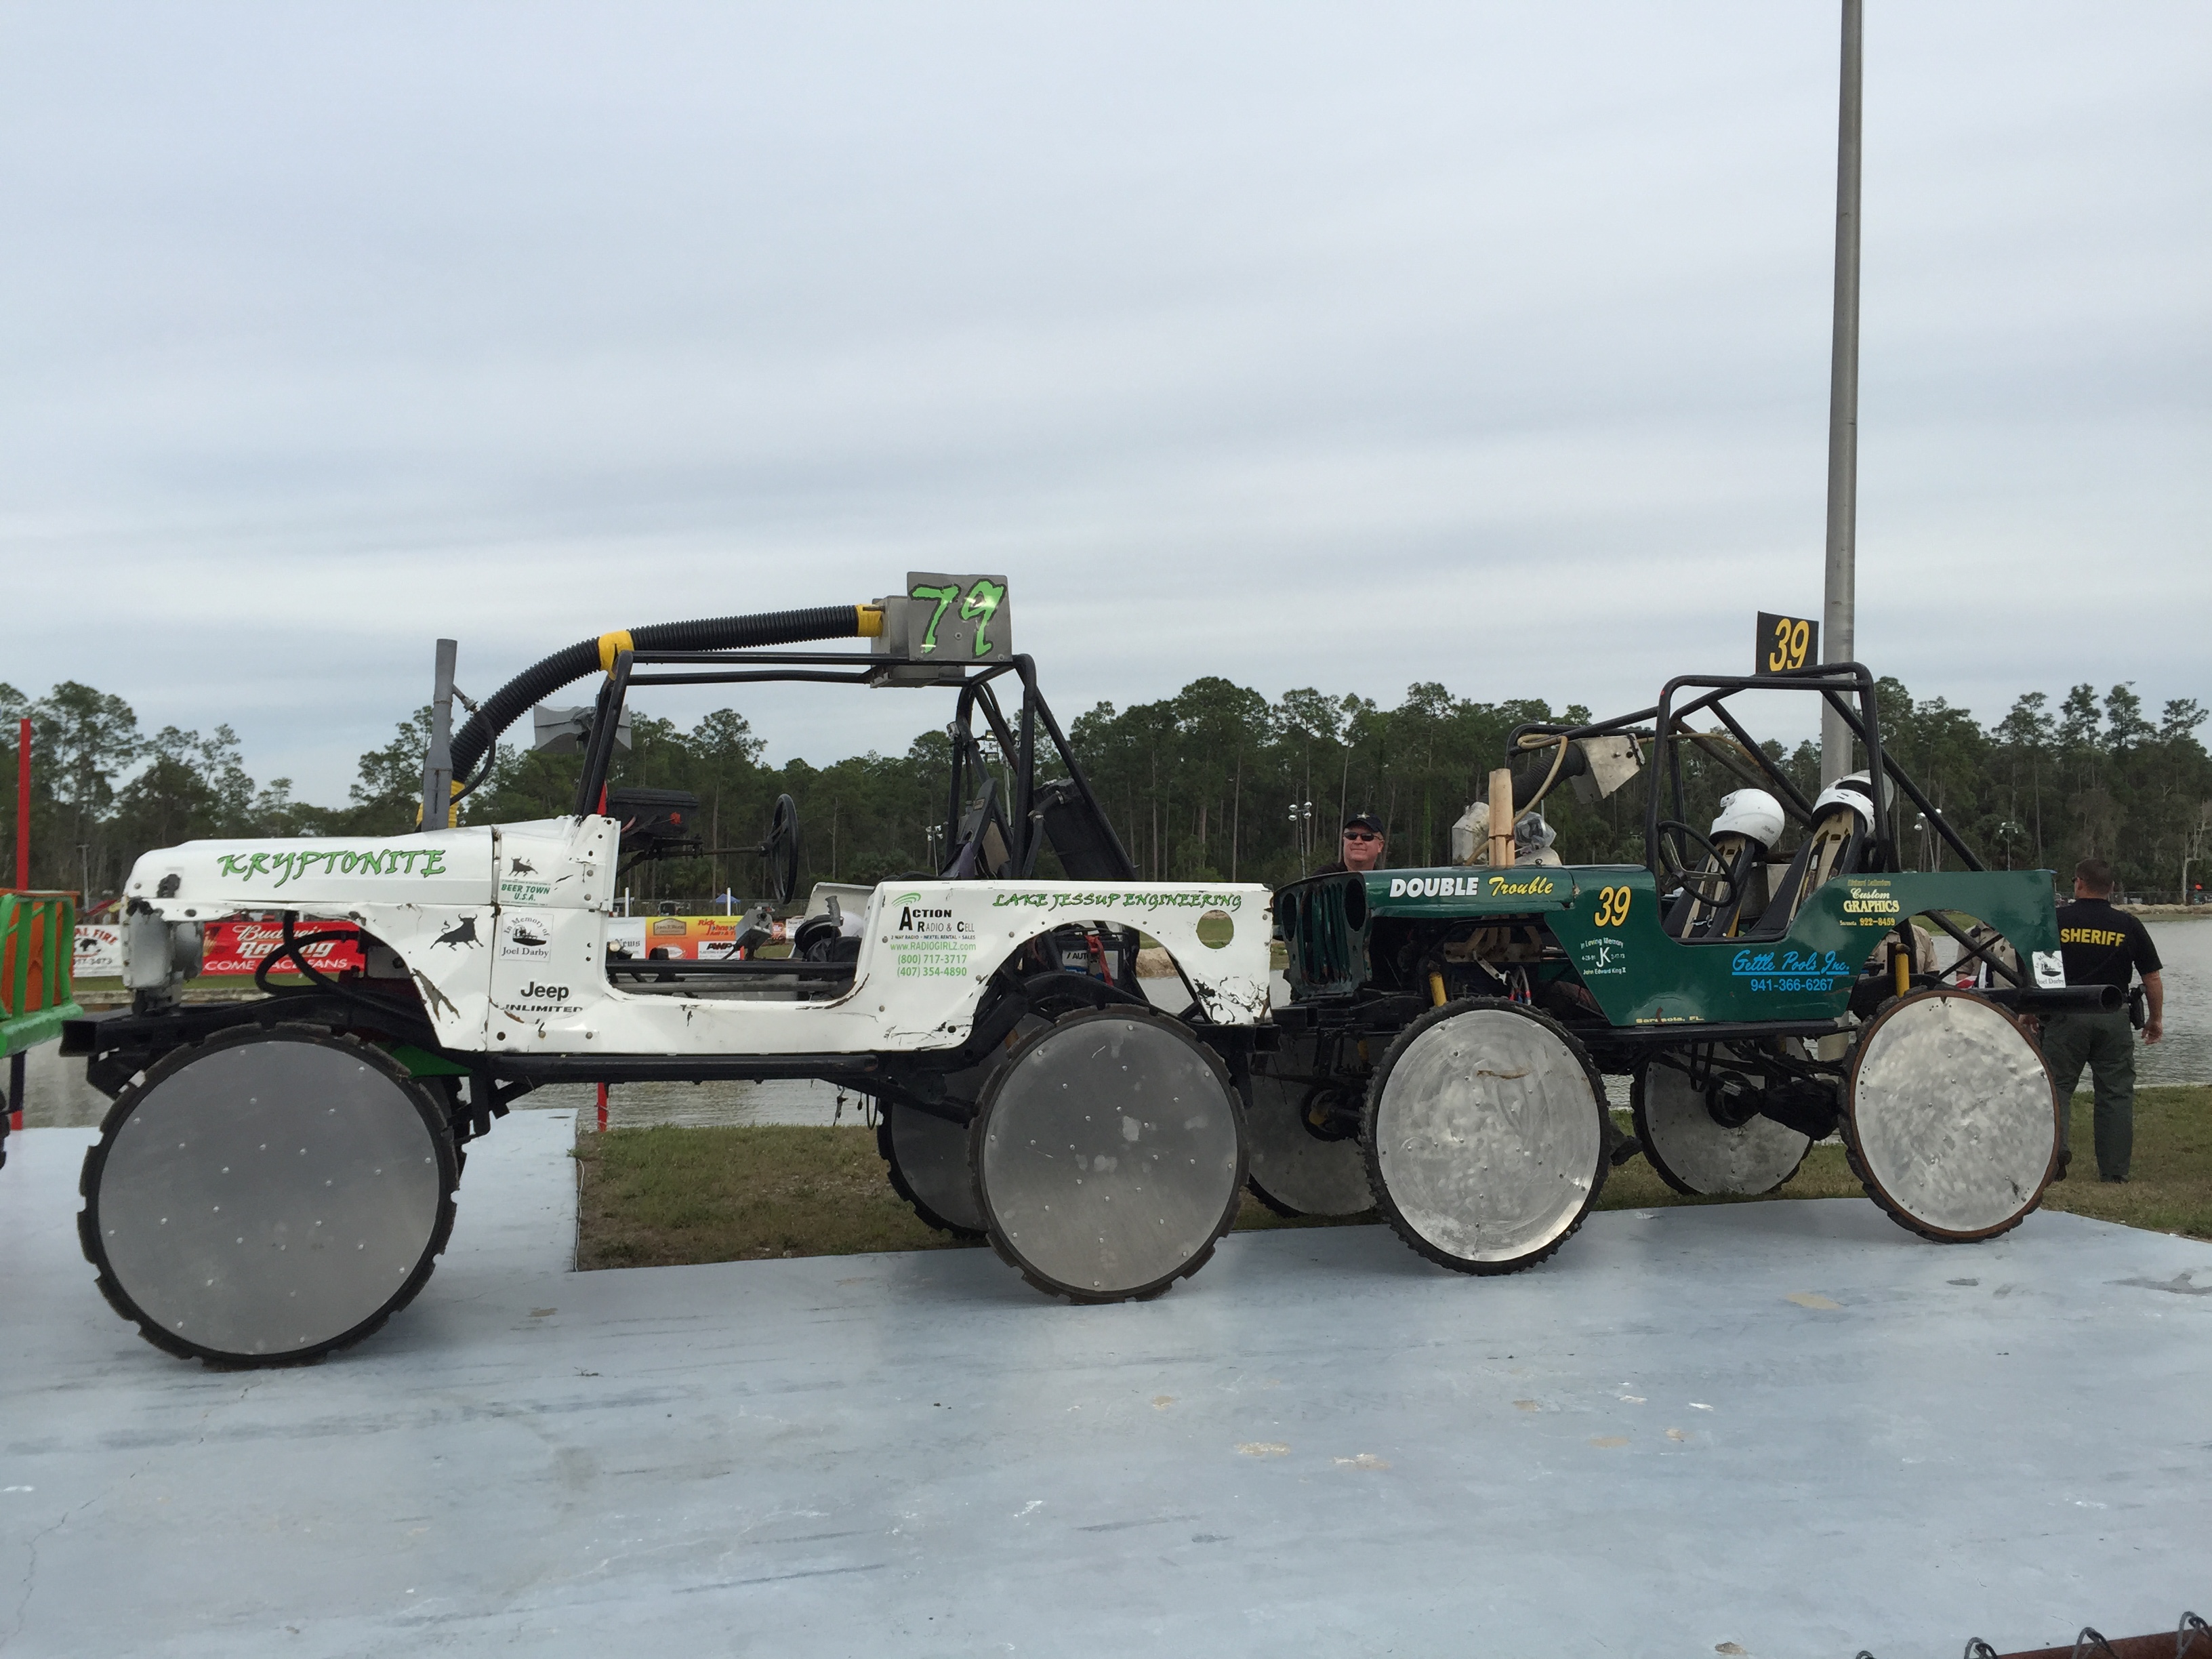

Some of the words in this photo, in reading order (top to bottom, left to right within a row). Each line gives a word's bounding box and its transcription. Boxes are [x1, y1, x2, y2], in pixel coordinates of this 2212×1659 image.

[909, 579, 1007, 659] 79
[1769, 617, 1809, 672] 39
[217, 849, 446, 888] KRYPTONITE
[501, 884, 523, 893] BEER
[526, 885, 551, 895] TOWN
[1389, 877, 1479, 897] DOUBLE
[1488, 876, 1553, 897] Trouble
[1850, 887, 1890, 899] Custom
[514, 893, 536, 901] U.S.A.
[992, 893, 1048, 907] LAKE
[1048, 893, 1120, 912] JESSUP
[1123, 893, 1243, 913] ENGINEERING
[1594, 885, 1632, 928] 39
[1843, 899, 1900, 913] GRAPHICS
[899, 906, 952, 931] ACTION
[1859, 917, 1896, 926] 922-8459
[74, 927, 88, 936] AL
[504, 925, 513, 935] In
[512, 917, 545, 928] Memory
[542, 928, 551, 937] of
[917, 921, 944, 933] RADIO
[946, 922, 952, 932] &
[957, 921, 975, 933] CELL
[1584, 938, 1602, 947] Loving
[1603, 937, 1624, 948] Memory
[2060, 928, 2126, 947] SHERIFF
[890, 941, 977, 951] www.RADIOGIRLZ.com
[501, 947, 520, 957] Joel
[522, 947, 550, 959] Darby
[898, 954, 921, 965] (800)
[924, 954, 967, 964] 717-3717
[1596, 946, 1612, 968] JK
[203, 960, 255, 971] COME
[1732, 949, 1776, 971] Gettle
[1782, 951, 1818, 971] Pools
[1820, 950, 1850, 975] Inc.
[897, 967, 921, 977] (407)
[923, 966, 967, 977] 354-4890
[520, 981, 569, 1002] Jeep
[1750, 979, 1833, 991] 941-366-6267
